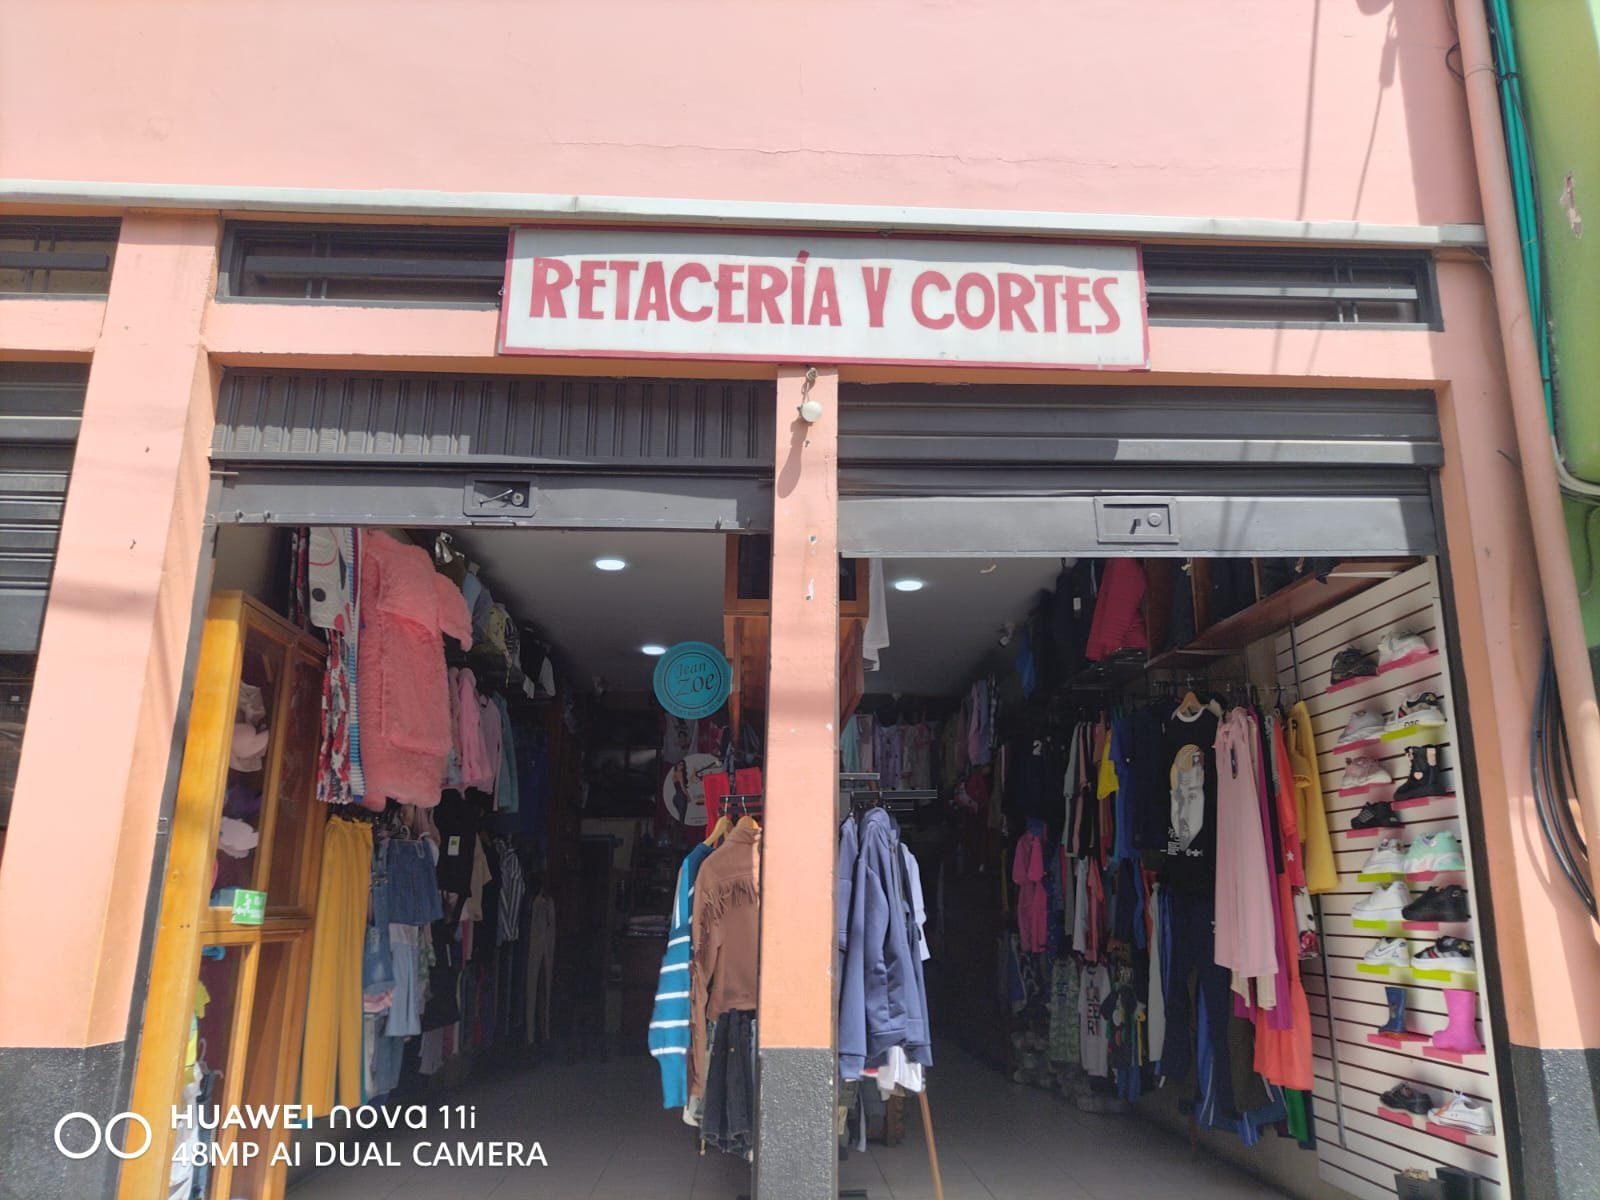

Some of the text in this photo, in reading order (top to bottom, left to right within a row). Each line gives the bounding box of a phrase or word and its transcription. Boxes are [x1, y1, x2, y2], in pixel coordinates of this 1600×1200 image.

[529, 250, 1121, 334] RETACERÍA Y CORTES
